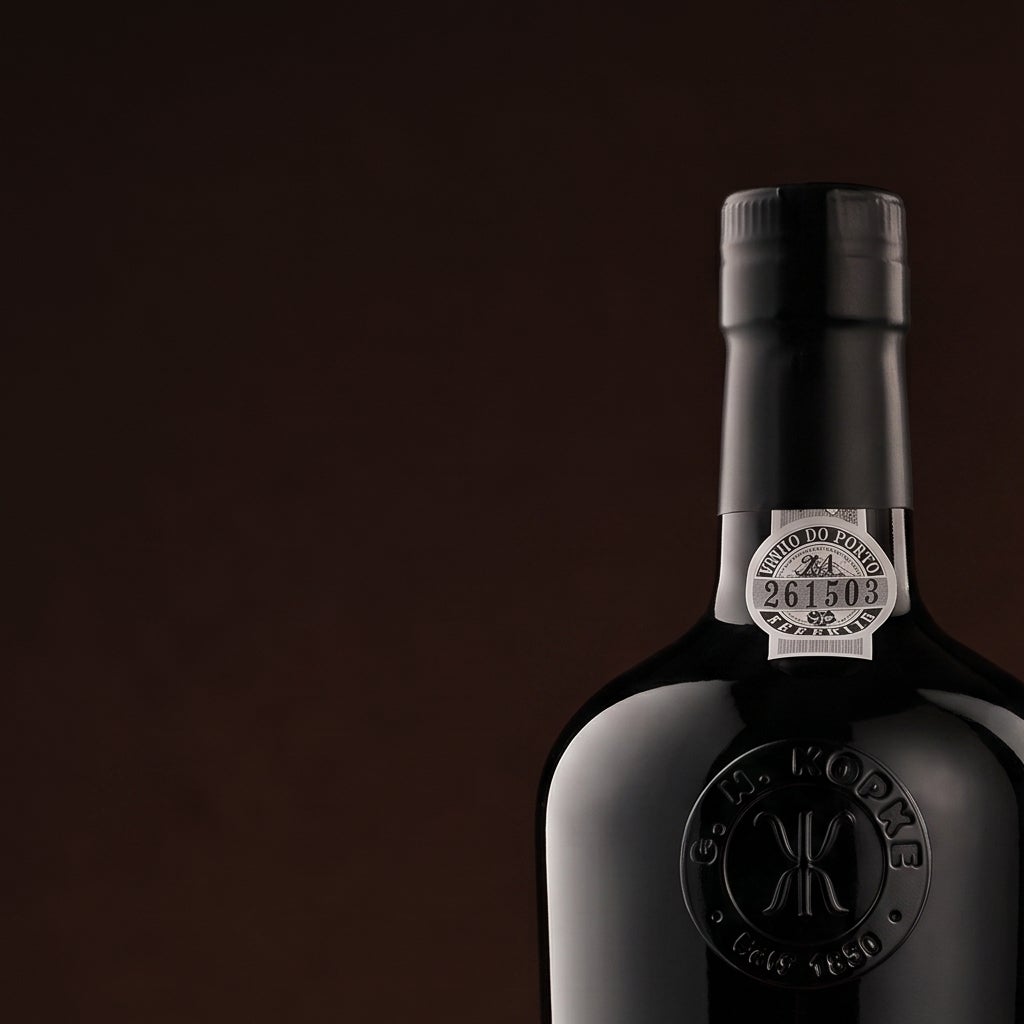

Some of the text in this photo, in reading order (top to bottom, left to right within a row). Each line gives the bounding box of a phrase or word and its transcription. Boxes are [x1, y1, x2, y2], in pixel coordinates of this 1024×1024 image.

[805, 528, 829, 542] DO
[835, 530, 881, 574] PORTO
[764, 578, 879, 608] 261503
[791, 744, 924, 870] KOPKE
